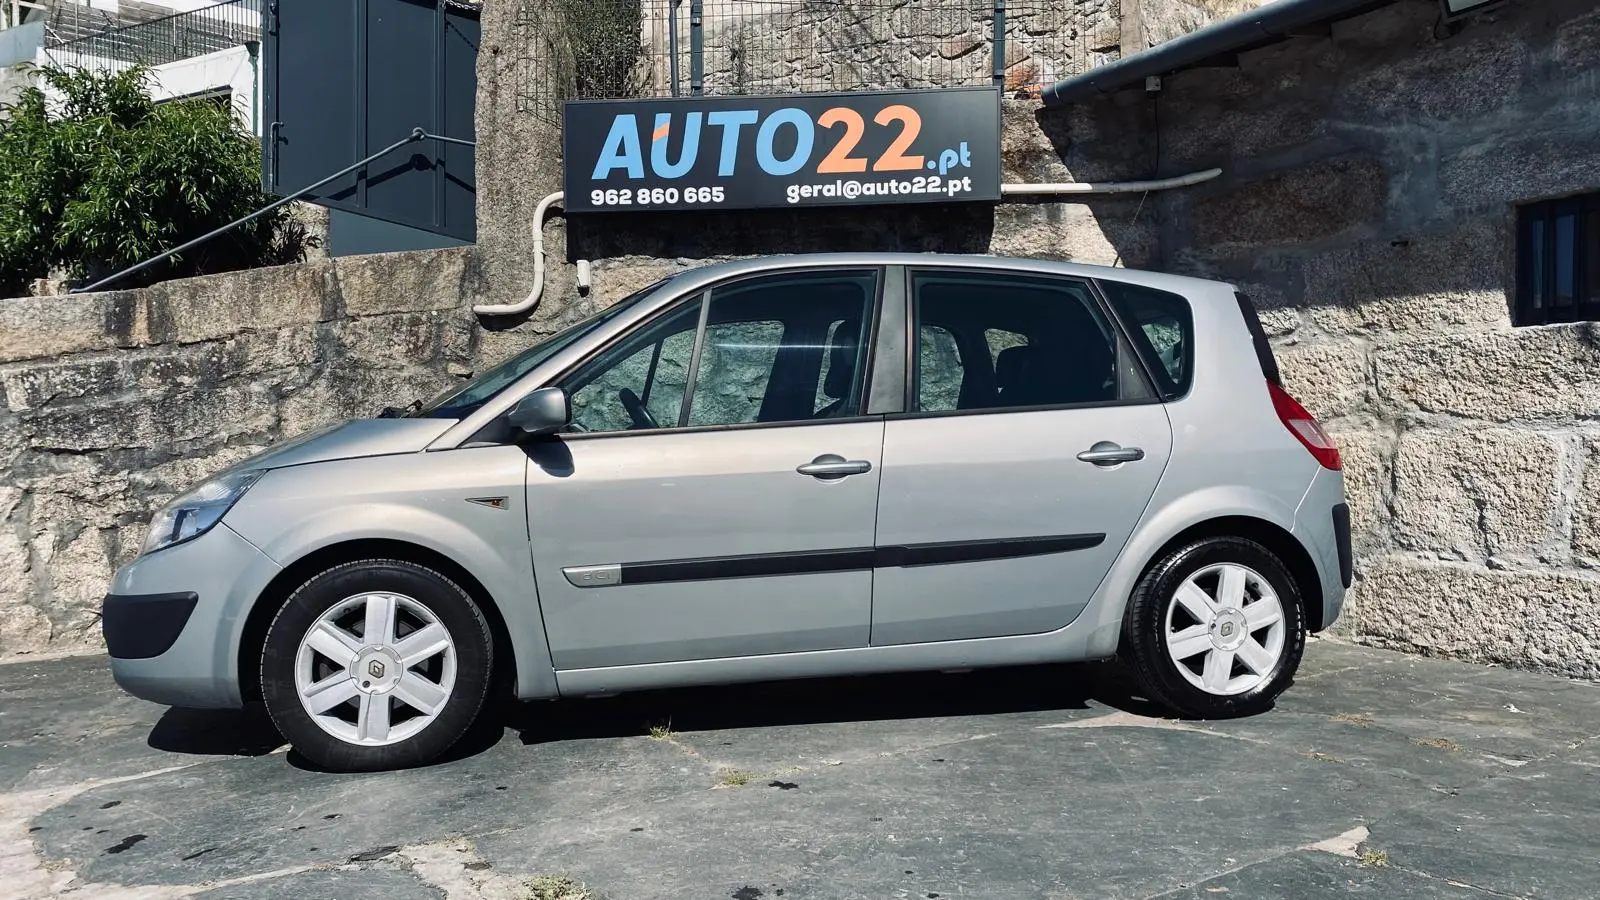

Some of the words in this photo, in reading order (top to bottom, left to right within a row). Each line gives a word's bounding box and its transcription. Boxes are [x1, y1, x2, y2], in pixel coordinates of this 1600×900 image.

[591, 104, 972, 180] AUTO22.pt
[590, 188, 633, 206] 962
[636, 187, 679, 205] 860
[683, 186, 725, 204] 665
[786, 175, 972, 204] geral@auto22.pt
